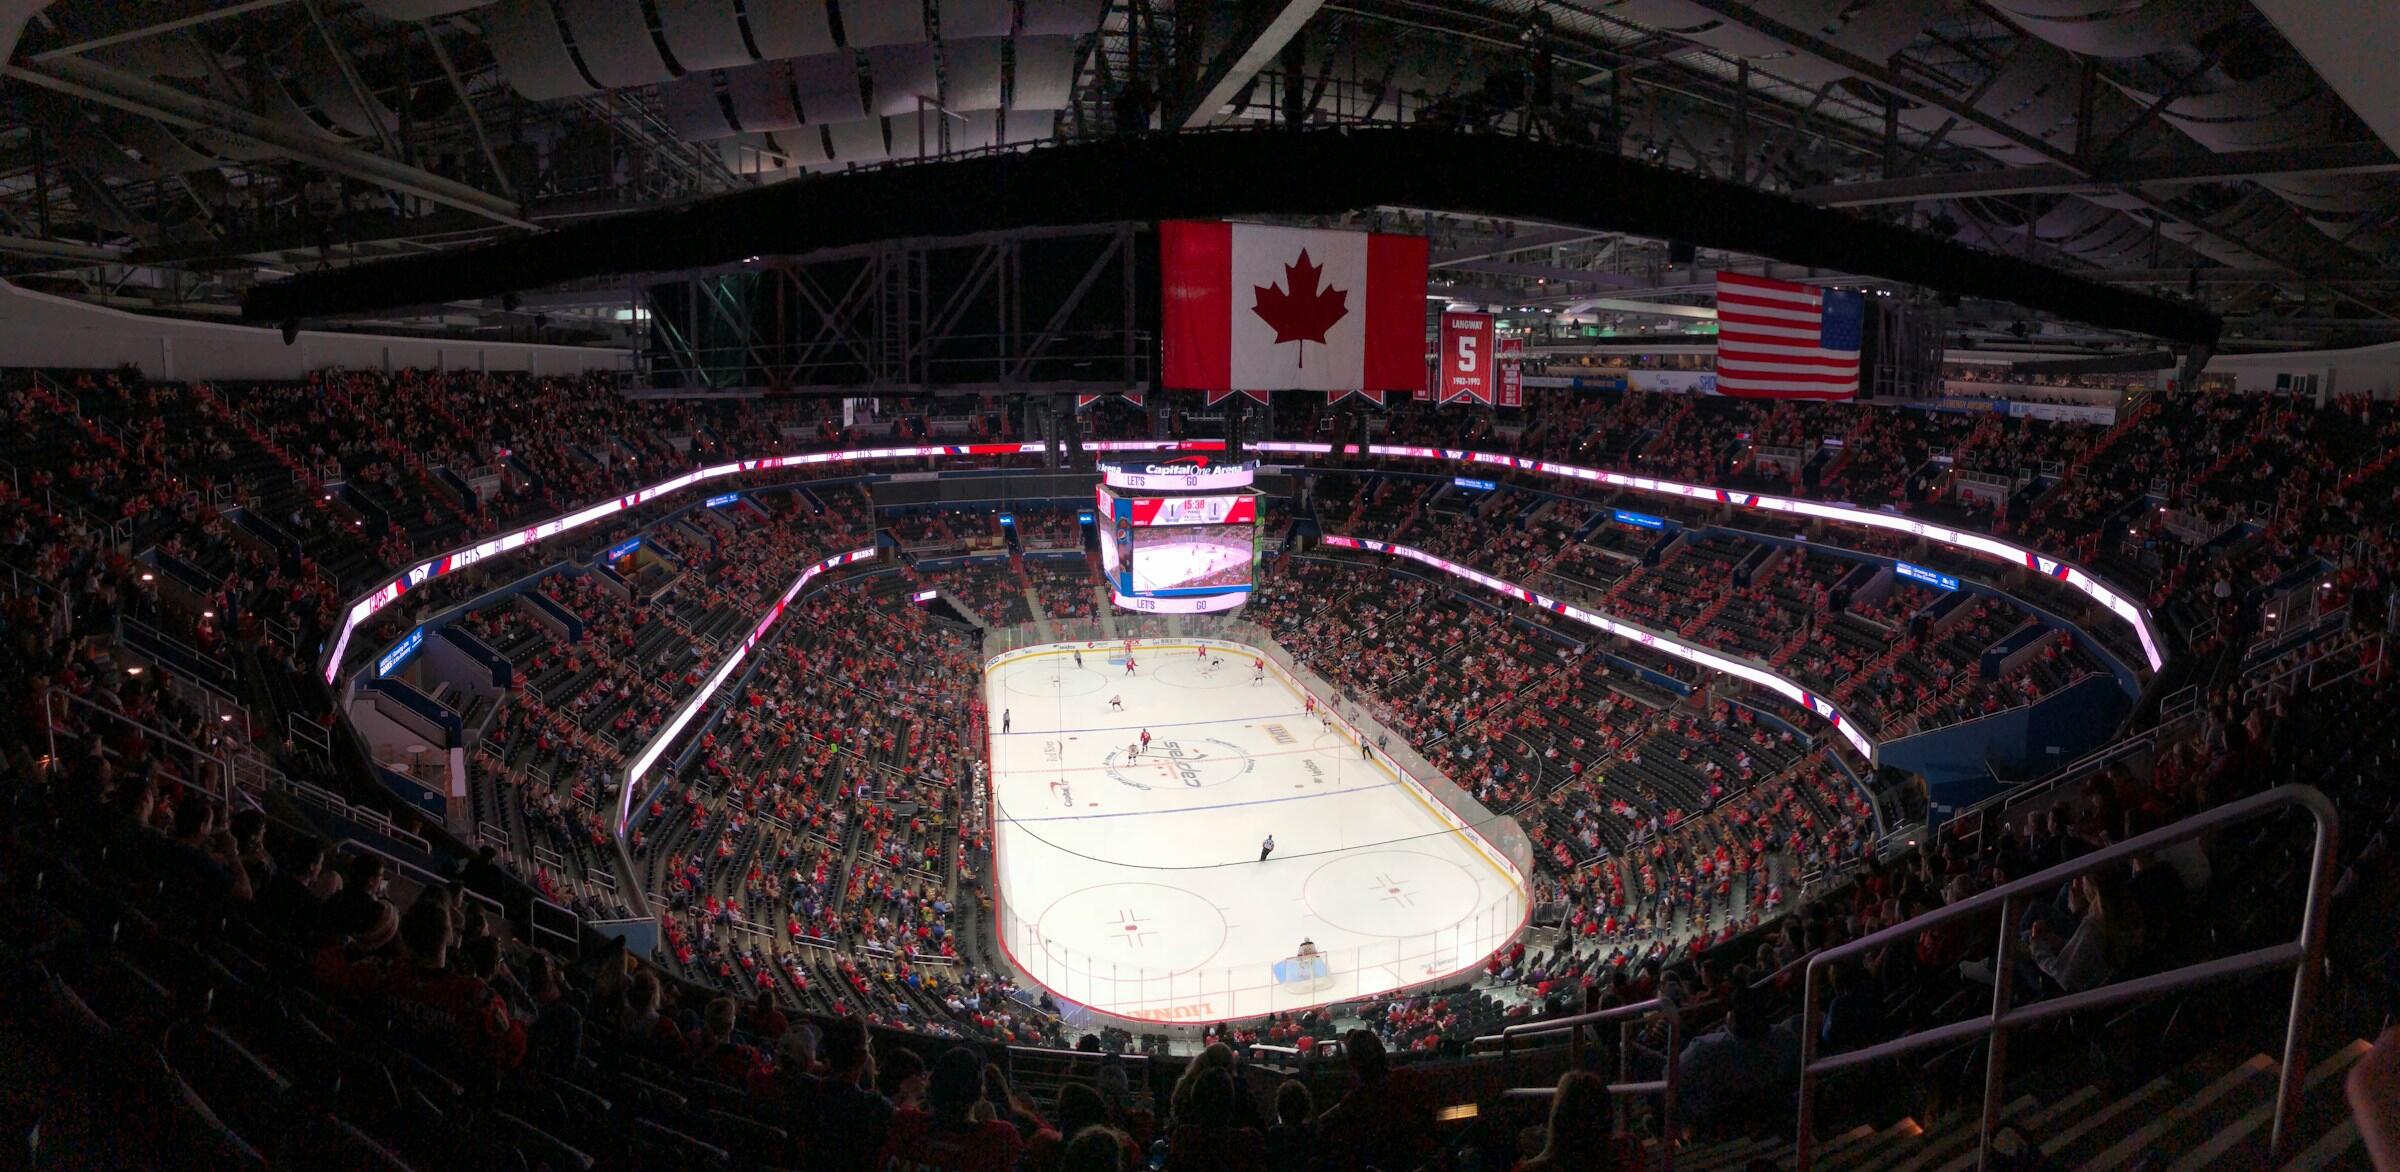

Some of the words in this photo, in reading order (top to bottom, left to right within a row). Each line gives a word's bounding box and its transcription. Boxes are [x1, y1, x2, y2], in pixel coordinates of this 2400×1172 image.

[1452, 319, 1483, 330] LANGWAY
[1458, 336, 1477, 372] 5
[1100, 463, 1122, 473] Arena
[1213, 465, 1243, 475] Arena
[1127, 475, 1145, 486] LET'S
[1186, 476, 1197, 486] GO
[1136, 600, 1155, 609] LET'S
[1196, 600, 1207, 609] GO
